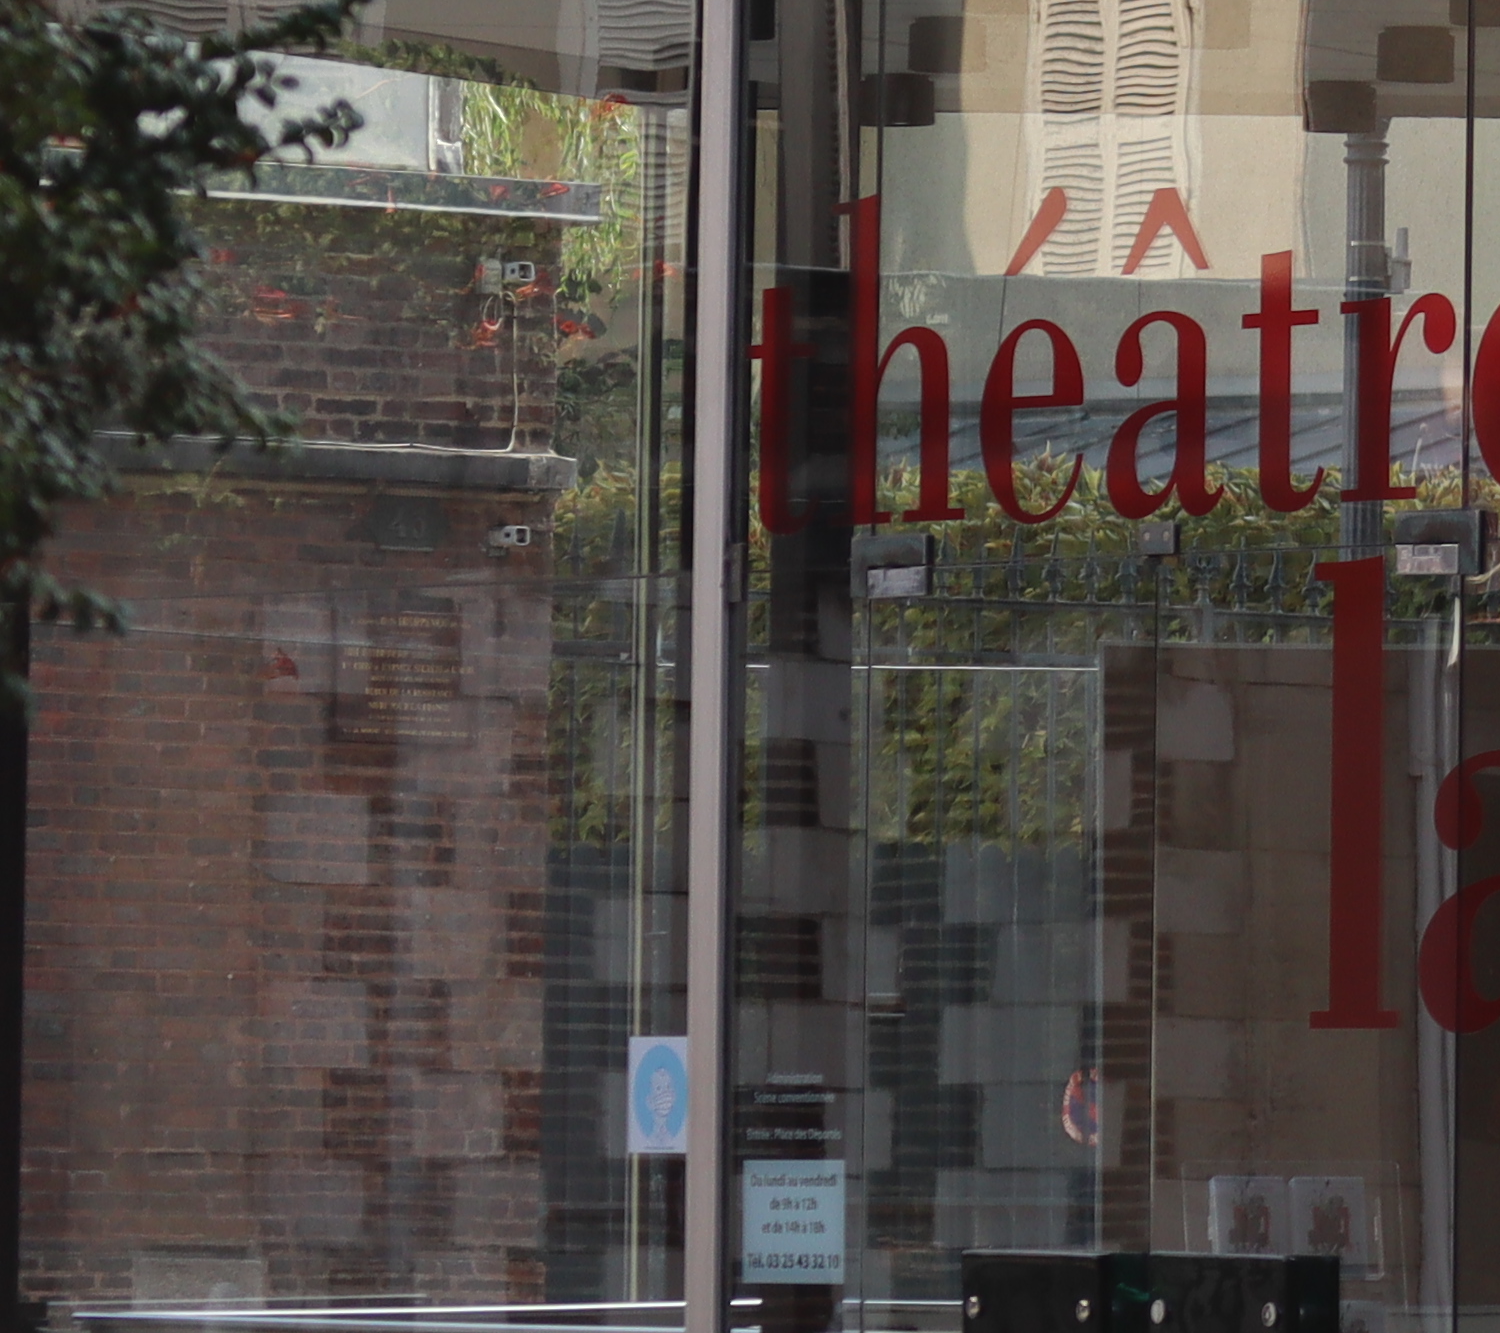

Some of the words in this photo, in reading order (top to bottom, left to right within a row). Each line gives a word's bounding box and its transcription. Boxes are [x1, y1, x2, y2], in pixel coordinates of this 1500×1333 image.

[766, 1254, 778, 1269] 03
[781, 1254, 794, 1269] 25
[797, 1254, 809, 1269] 43
[811, 1254, 824, 1269] 32
[827, 1254, 839, 1269] 10
